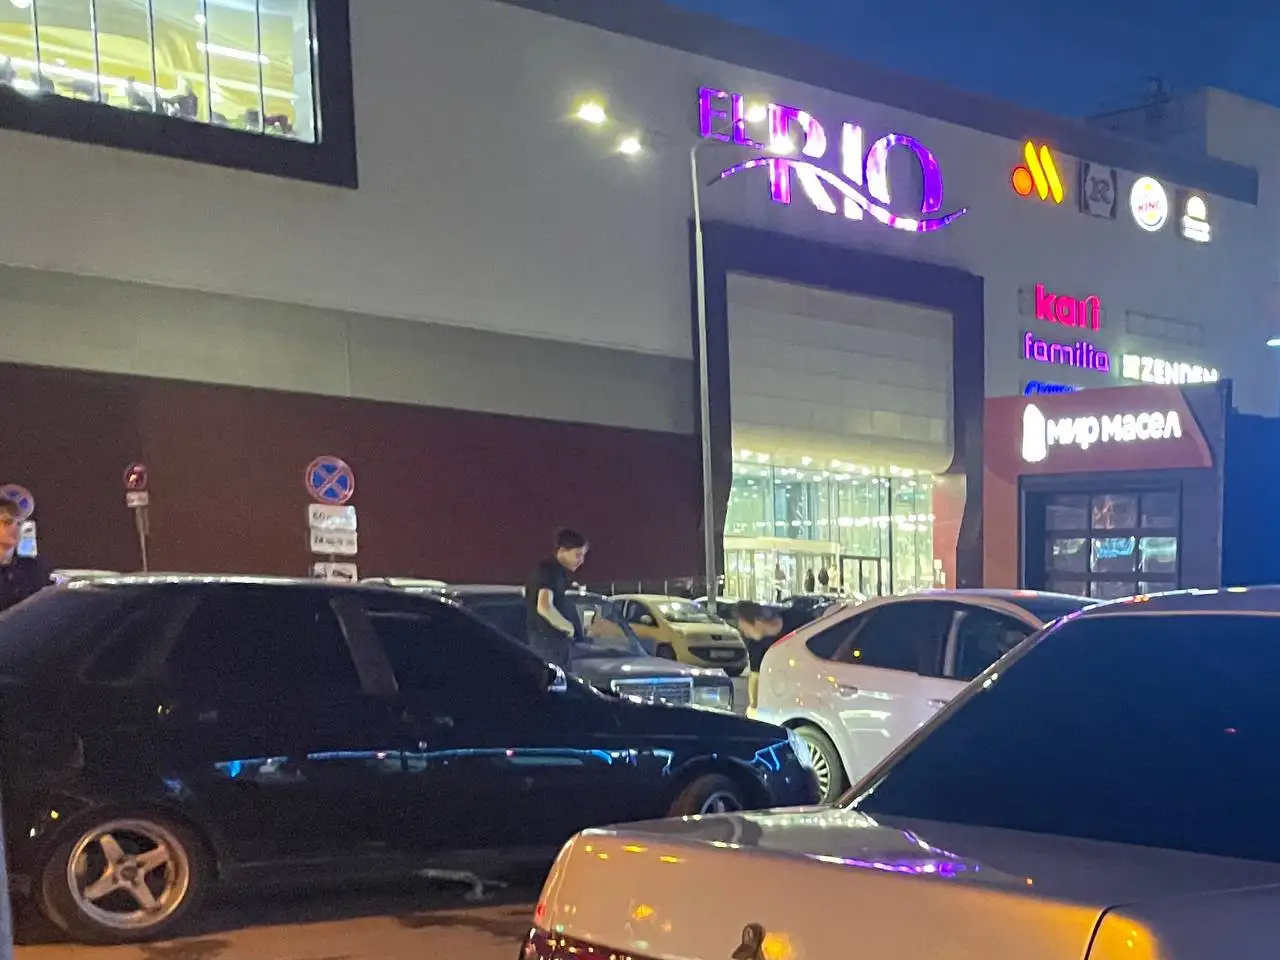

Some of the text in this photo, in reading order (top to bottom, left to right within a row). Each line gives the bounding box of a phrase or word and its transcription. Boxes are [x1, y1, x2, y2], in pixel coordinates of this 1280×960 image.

[769, 102, 944, 221] RIO
[1035, 283, 1100, 331] kari
[1024, 332, 1109, 373] familia
